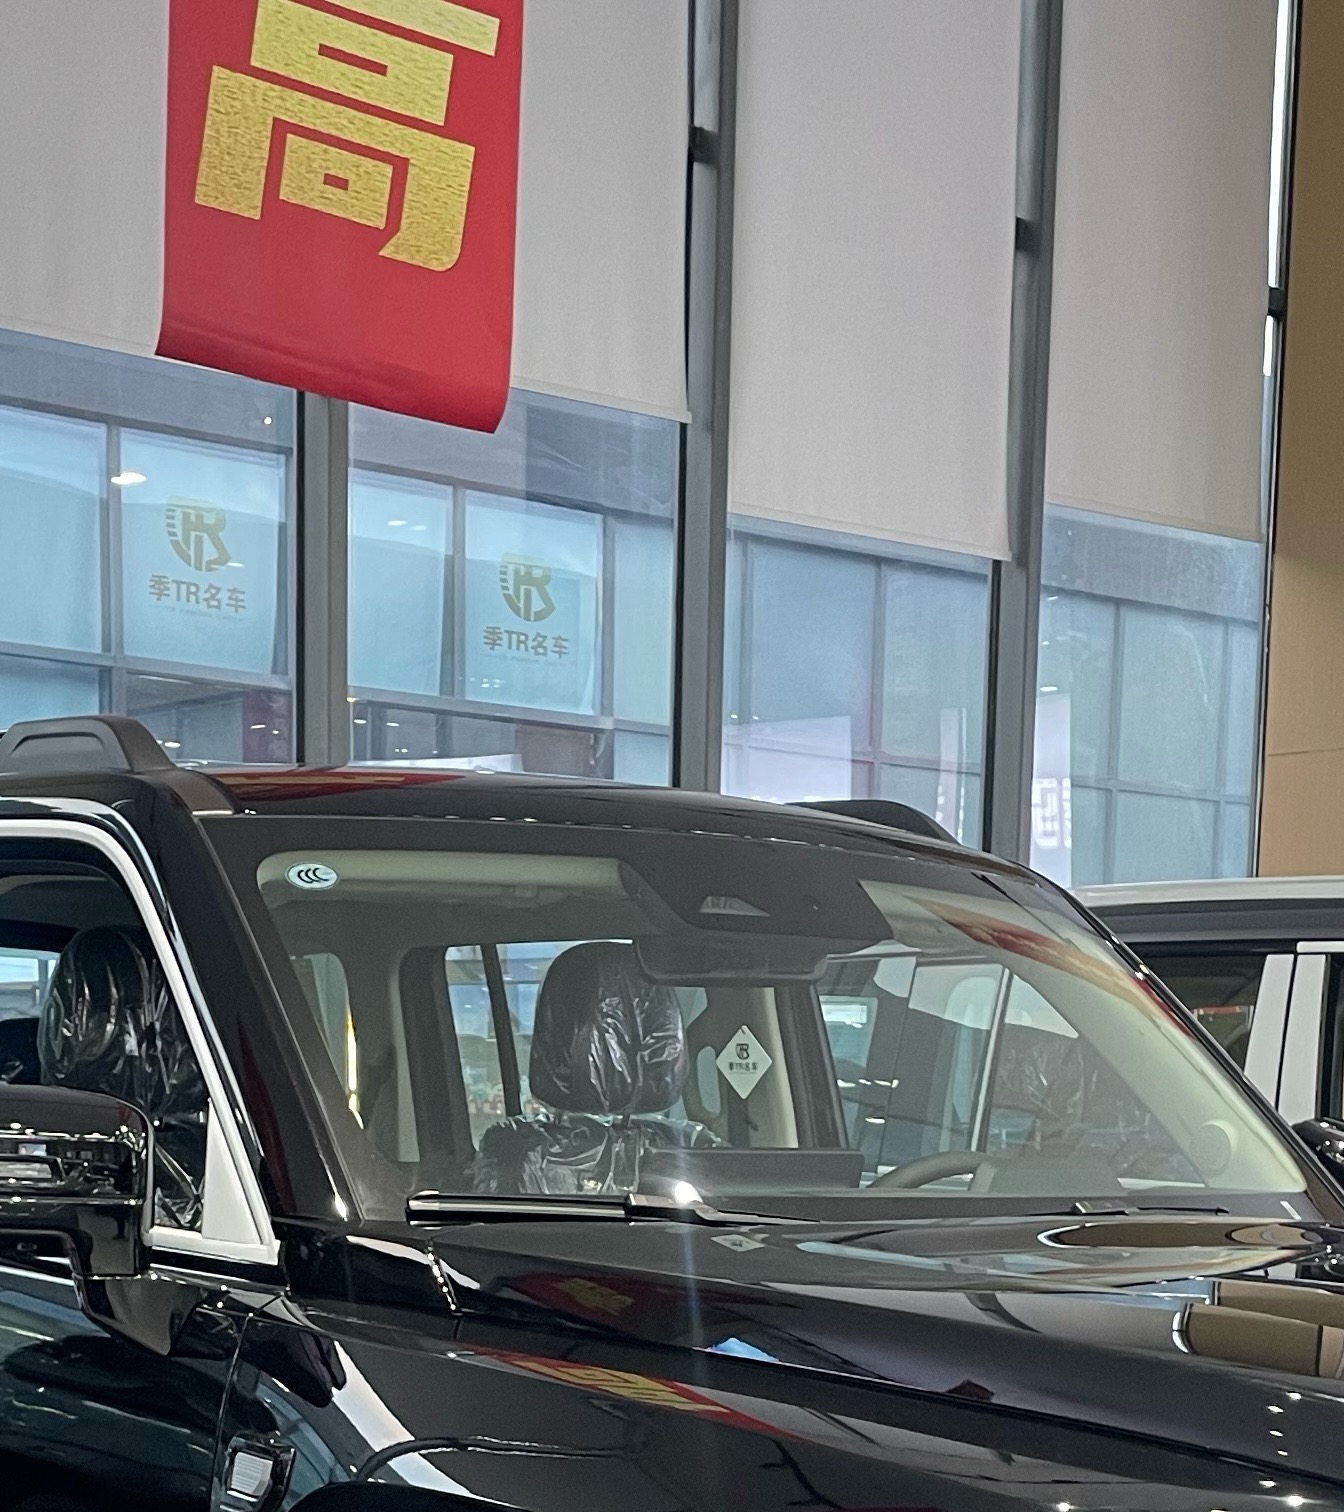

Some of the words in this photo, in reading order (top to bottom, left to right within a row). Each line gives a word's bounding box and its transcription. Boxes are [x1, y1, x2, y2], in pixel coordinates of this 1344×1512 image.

[194, 0, 500, 272] 高
[148, 574, 246, 614] 季TR名车
[482, 625, 570, 659] 季TR名车
